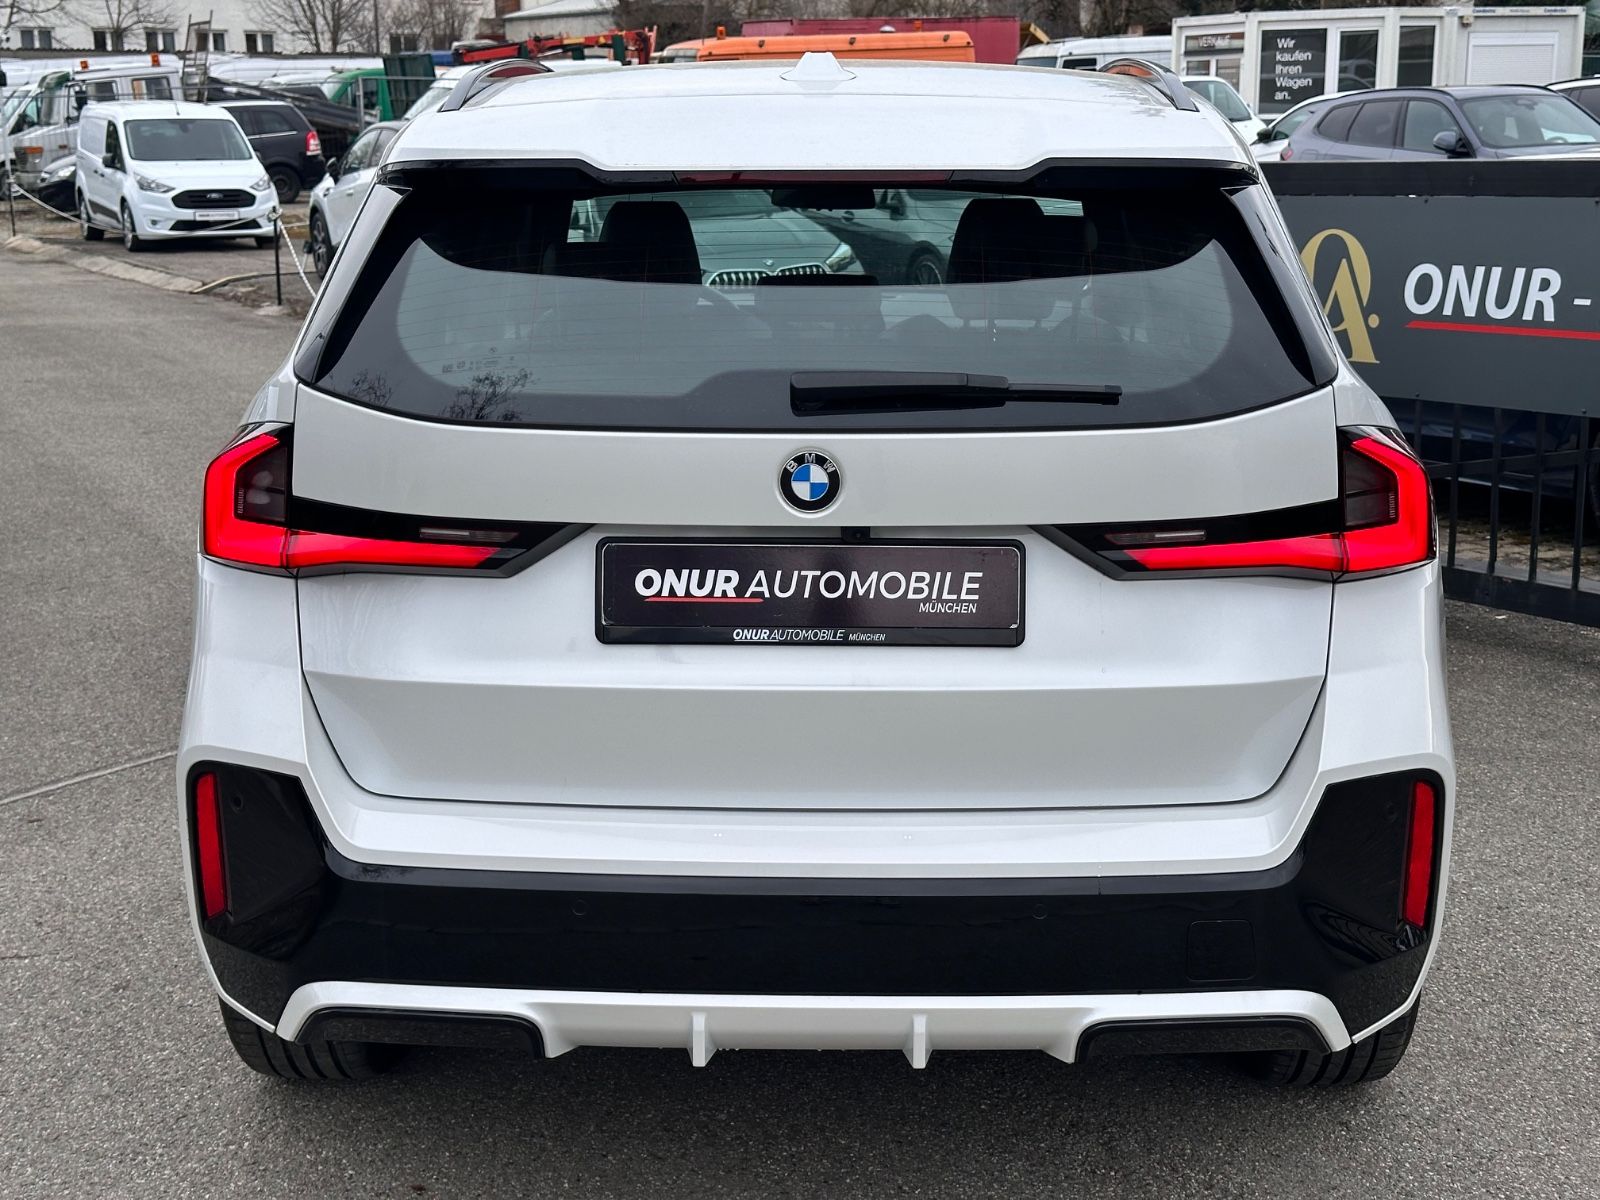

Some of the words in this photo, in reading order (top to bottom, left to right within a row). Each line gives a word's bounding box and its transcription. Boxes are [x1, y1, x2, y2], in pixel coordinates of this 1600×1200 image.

[1198, 35, 1231, 47] VERKAUF
[1276, 37, 1296, 49] Wir
[1276, 50, 1312, 61] kaufen
[1275, 64, 1303, 75] Ihren
[1275, 77, 1313, 89] Wagen
[1274, 91, 1292, 101] an.
[1403, 262, 1562, 322] ONUR
[787, 453, 836, 473] BMW
[634, 568, 740, 598] ONUR
[745, 571, 983, 600] AUTOMOBILE
[918, 601, 977, 614] MÜNCHEN
[732, 628, 770, 641] ONUR
[770, 629, 845, 642] AUTOMOBILE
[848, 632, 886, 642] MÜNCHEN
